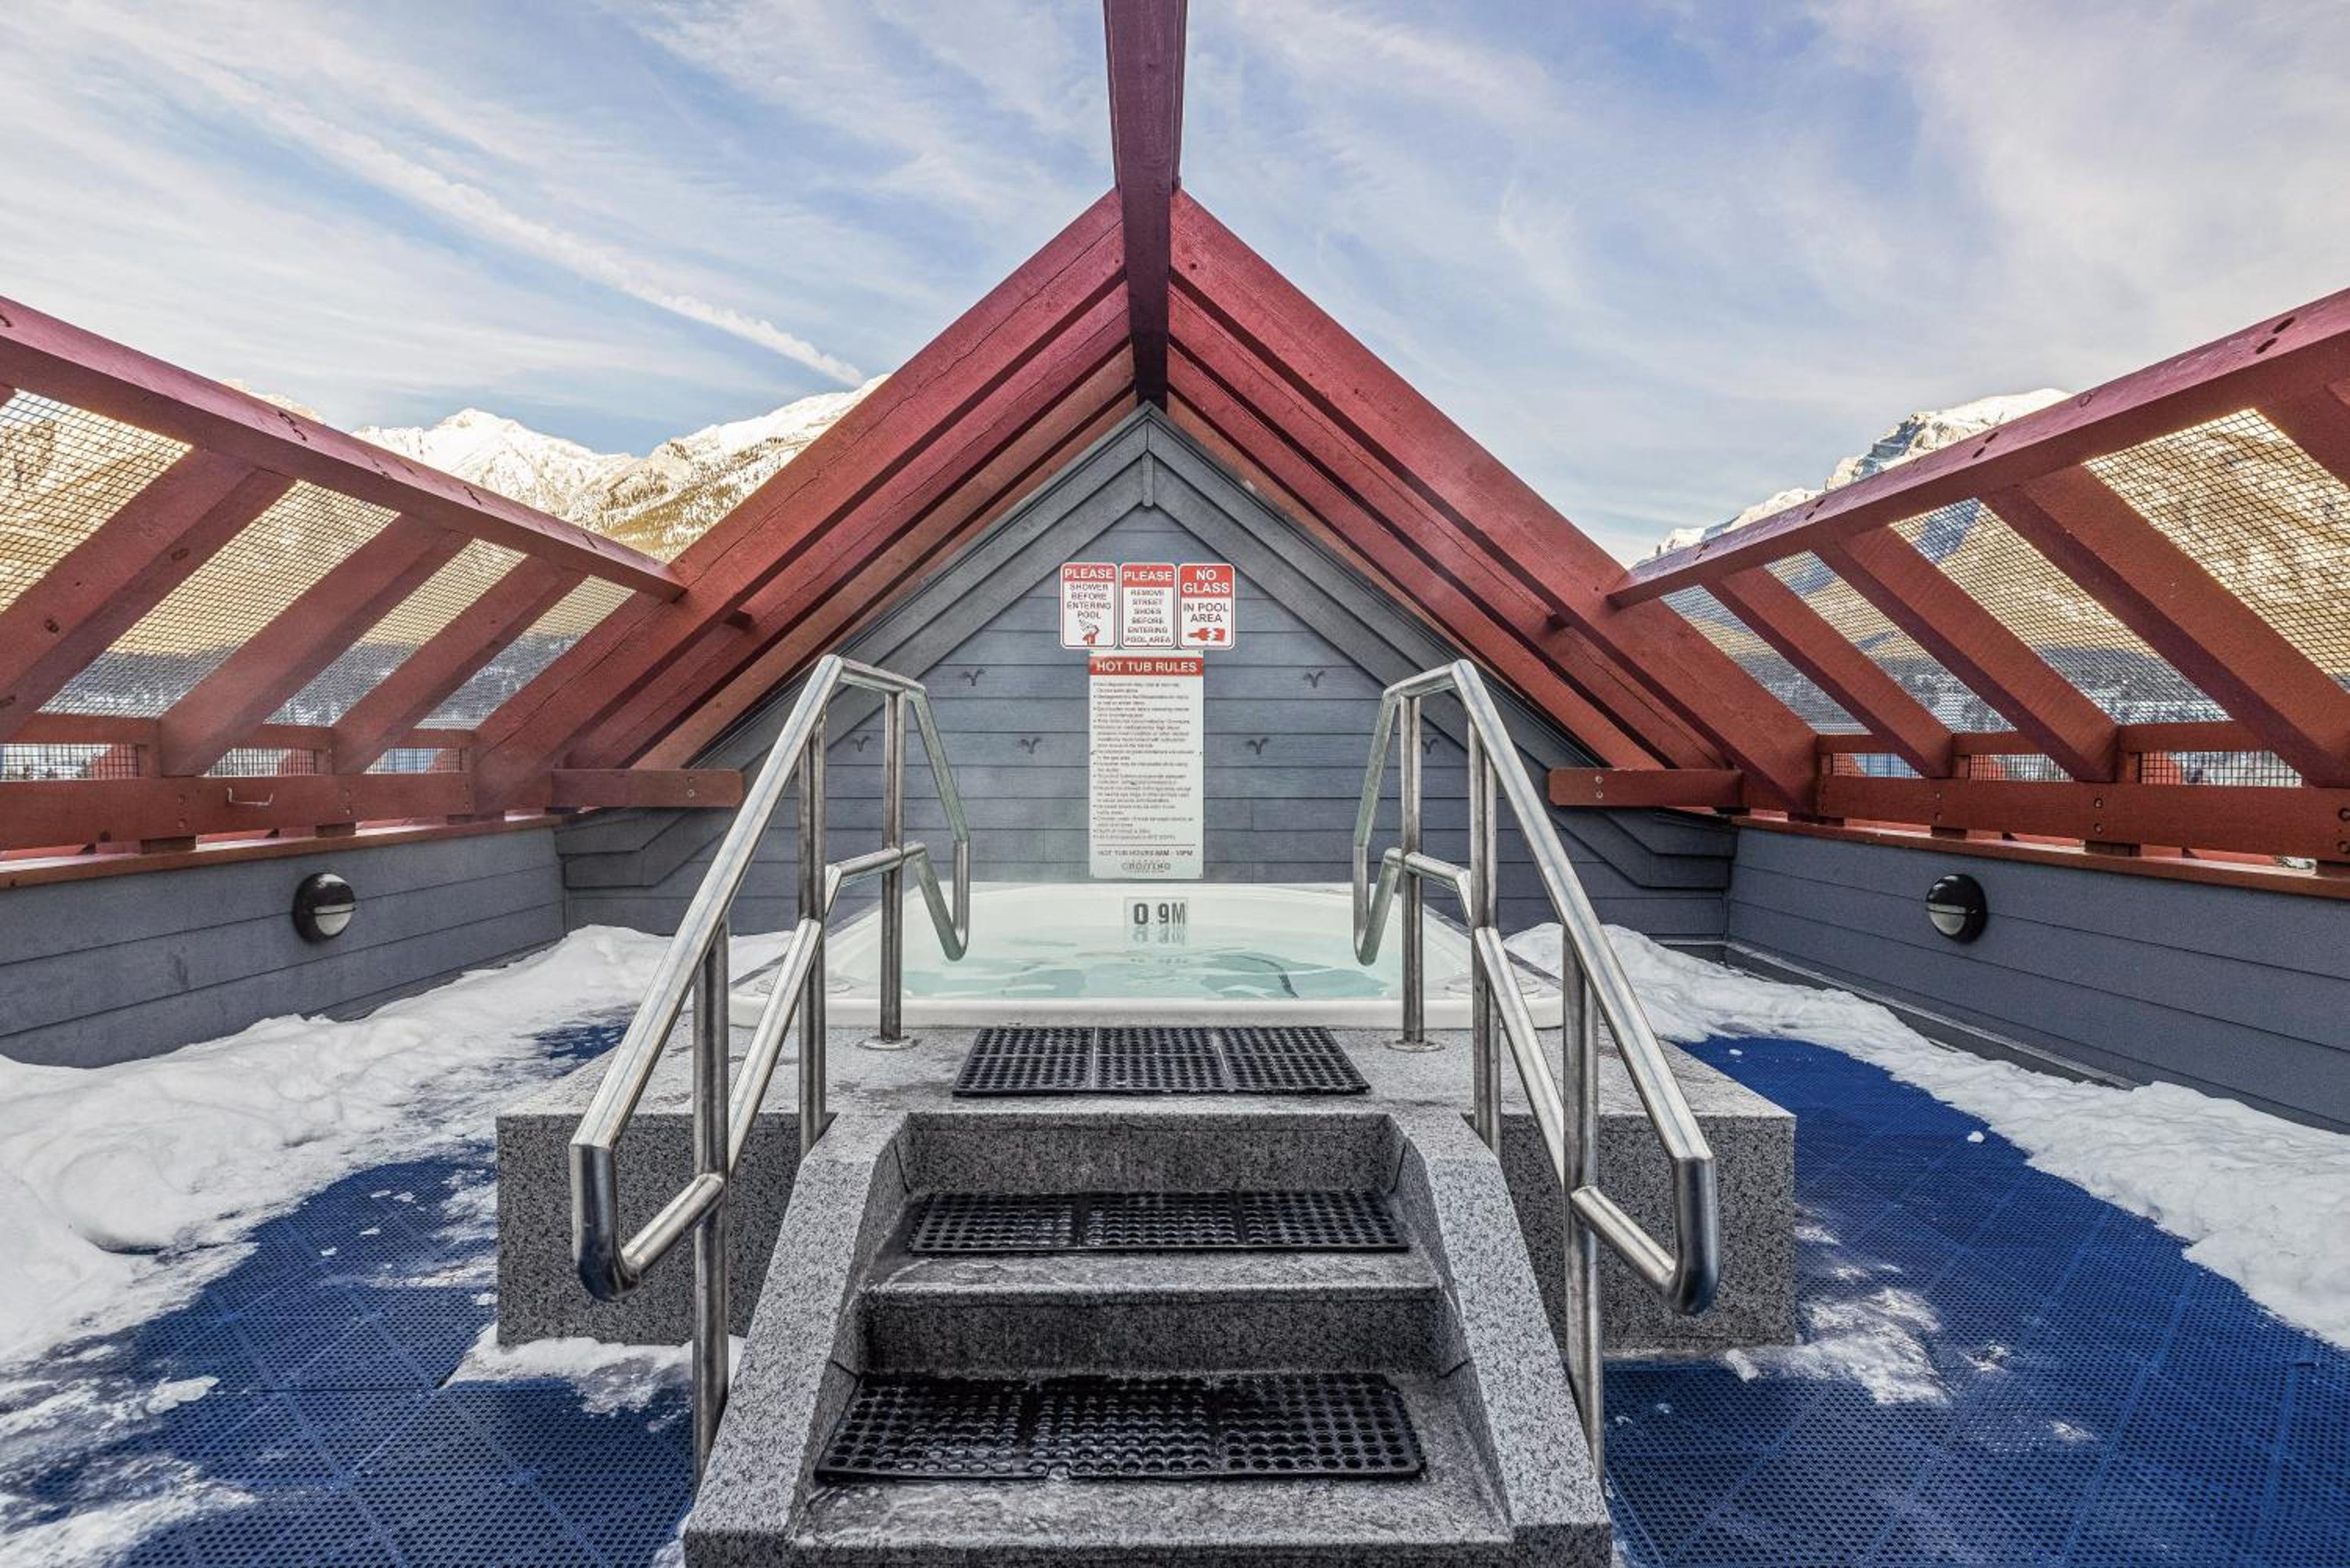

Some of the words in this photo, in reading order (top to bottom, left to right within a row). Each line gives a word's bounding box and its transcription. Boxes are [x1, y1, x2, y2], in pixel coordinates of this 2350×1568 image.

[1065, 568, 1114, 579] PLEASE
[1123, 571, 1173, 581] PLEASE
[1196, 570, 1217, 580] NO
[1183, 582, 1230, 594] GLASS
[1184, 602, 1195, 612] IN
[1198, 602, 1228, 612] POOL
[1191, 614, 1223, 623] AREA
[1097, 660, 1122, 671] HOT
[1126, 661, 1153, 672] TUB
[1155, 661, 1197, 673] RULES
